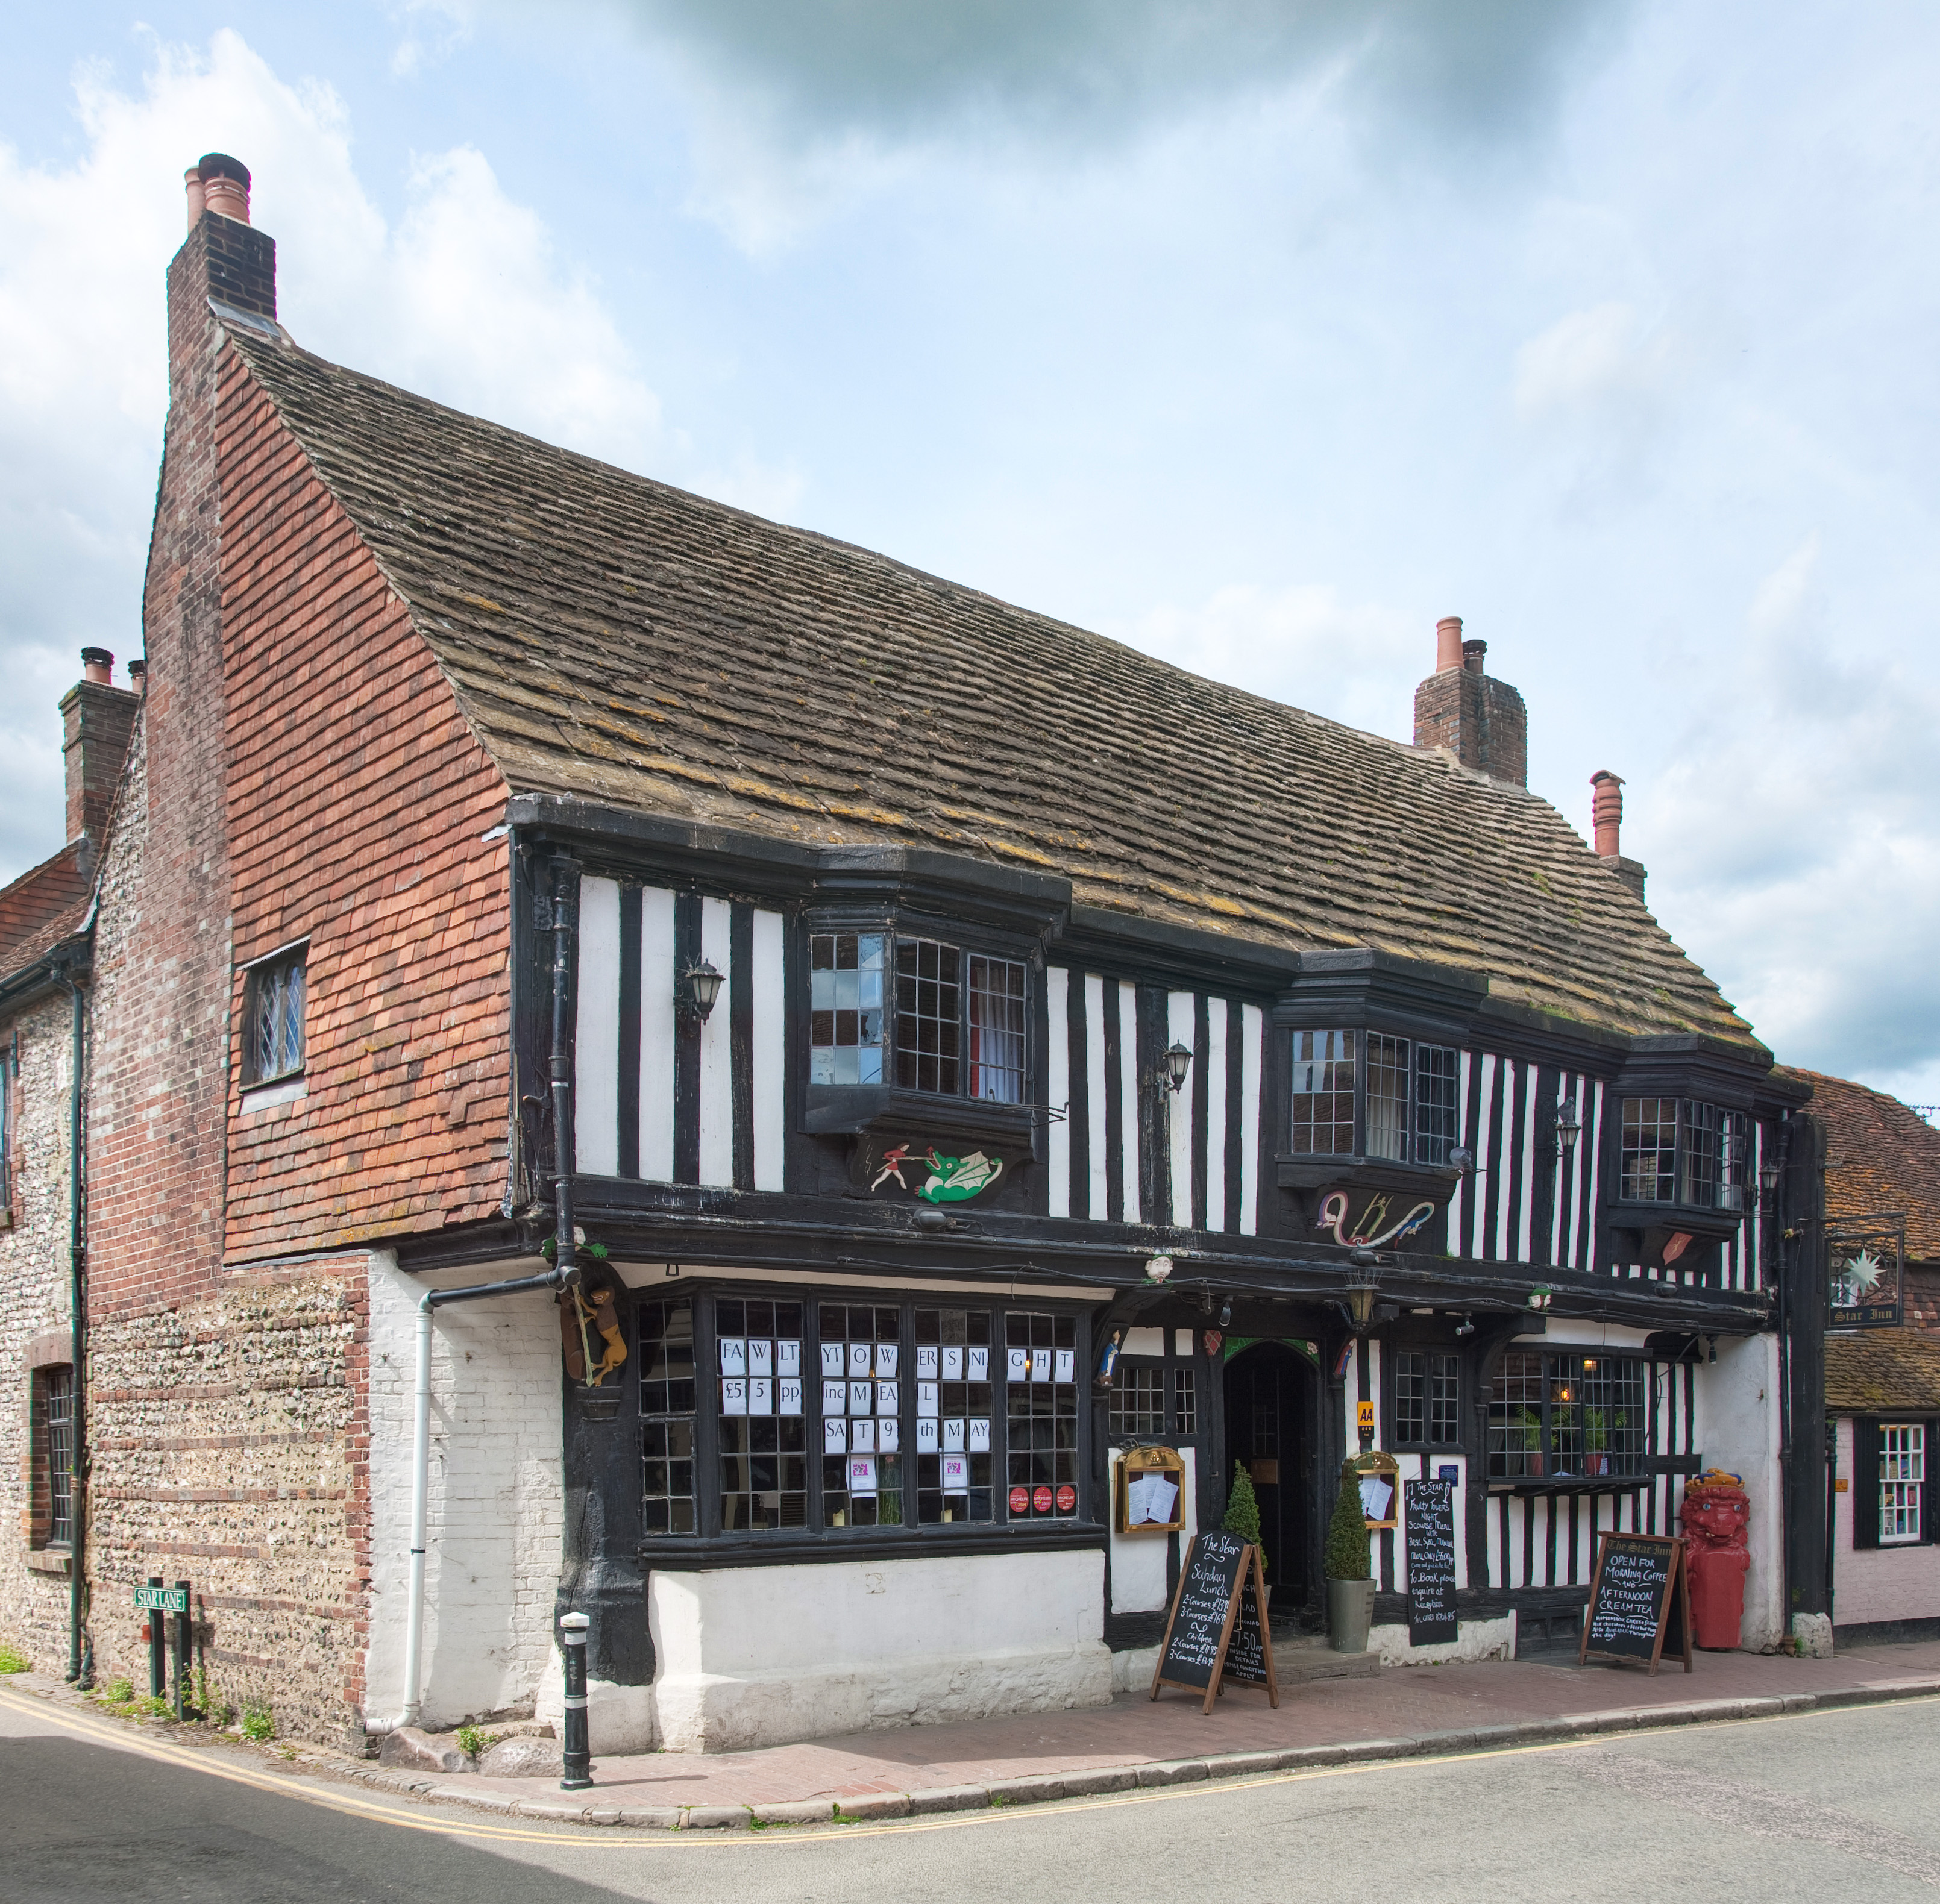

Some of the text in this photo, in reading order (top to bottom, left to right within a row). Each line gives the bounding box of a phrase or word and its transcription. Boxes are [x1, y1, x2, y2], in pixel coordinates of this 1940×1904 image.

[1835, 1308, 1894, 1322] Star Inn
[825, 1385, 844, 1399] inc
[1360, 1408, 1372, 1421] AA
[827, 1421, 868, 1438] SAT
[948, 1423, 988, 1438] MAY
[1428, 1481, 1443, 1491] STAR
[1421, 1512, 1439, 1522] NIGHT
[1202, 1533, 1240, 1555] The Star
[1607, 1539, 1672, 1556] The Star Inn
[1610, 1555, 1655, 1569] OPEN FOR
[1191, 1563, 1225, 1589] Sunday
[1199, 1580, 1229, 1596] Lunch
[1436, 1586, 1445, 1596] at
[1600, 1586, 1654, 1601] AFTERNOON
[137, 1589, 183, 1609] STAR LANE
[1599, 1600, 1654, 1619] CREAM TEA
[1235, 1656, 1259, 1666] DETAILS
[1235, 1671, 1255, 1680] APPLY
